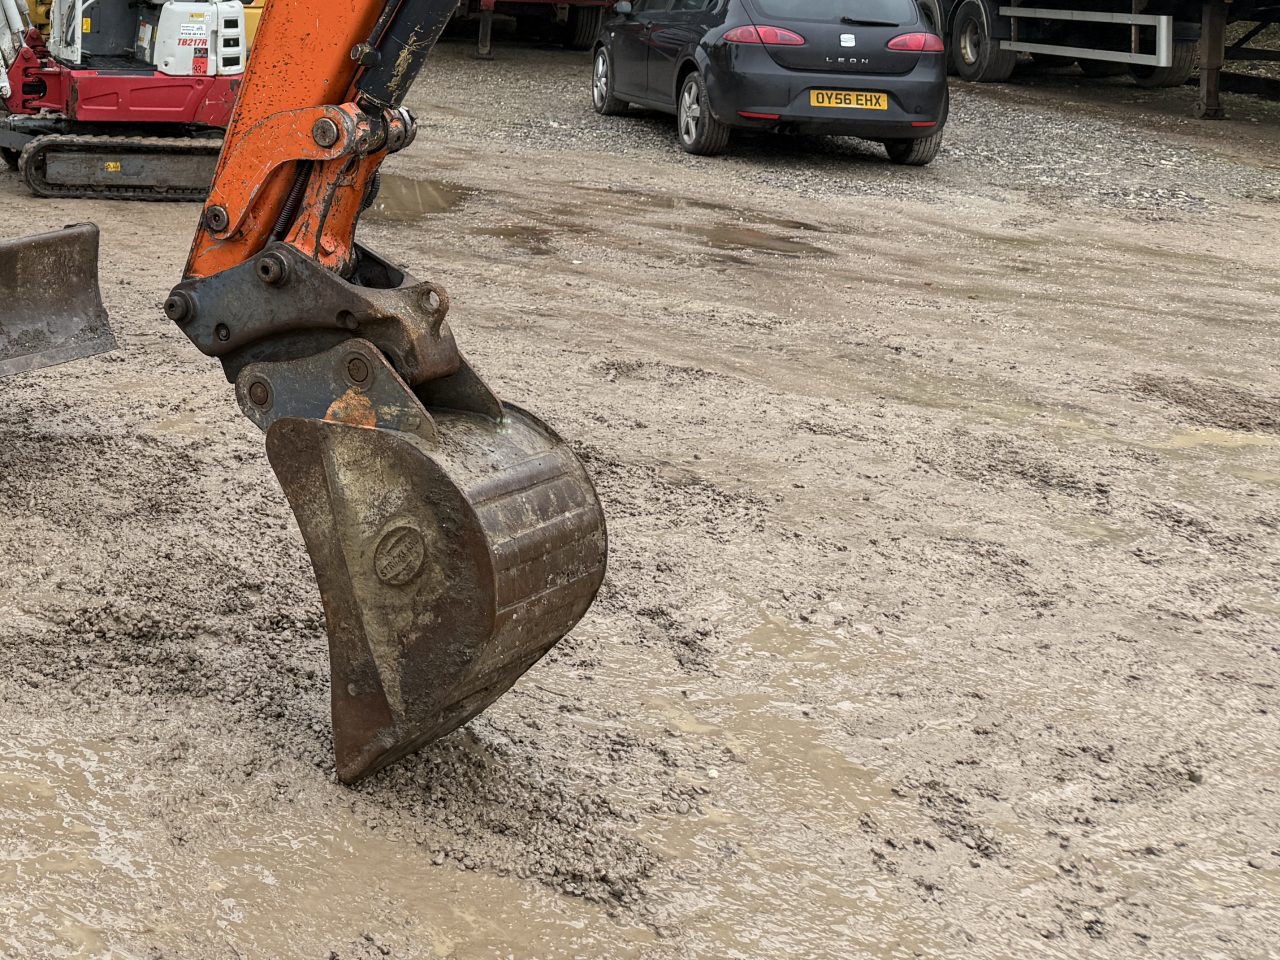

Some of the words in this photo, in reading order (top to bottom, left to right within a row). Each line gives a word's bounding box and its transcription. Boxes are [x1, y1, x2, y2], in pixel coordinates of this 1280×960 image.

[177, 38, 208, 47] TB217R
[816, 92, 852, 106] OY56
[855, 94, 882, 107] EHX
